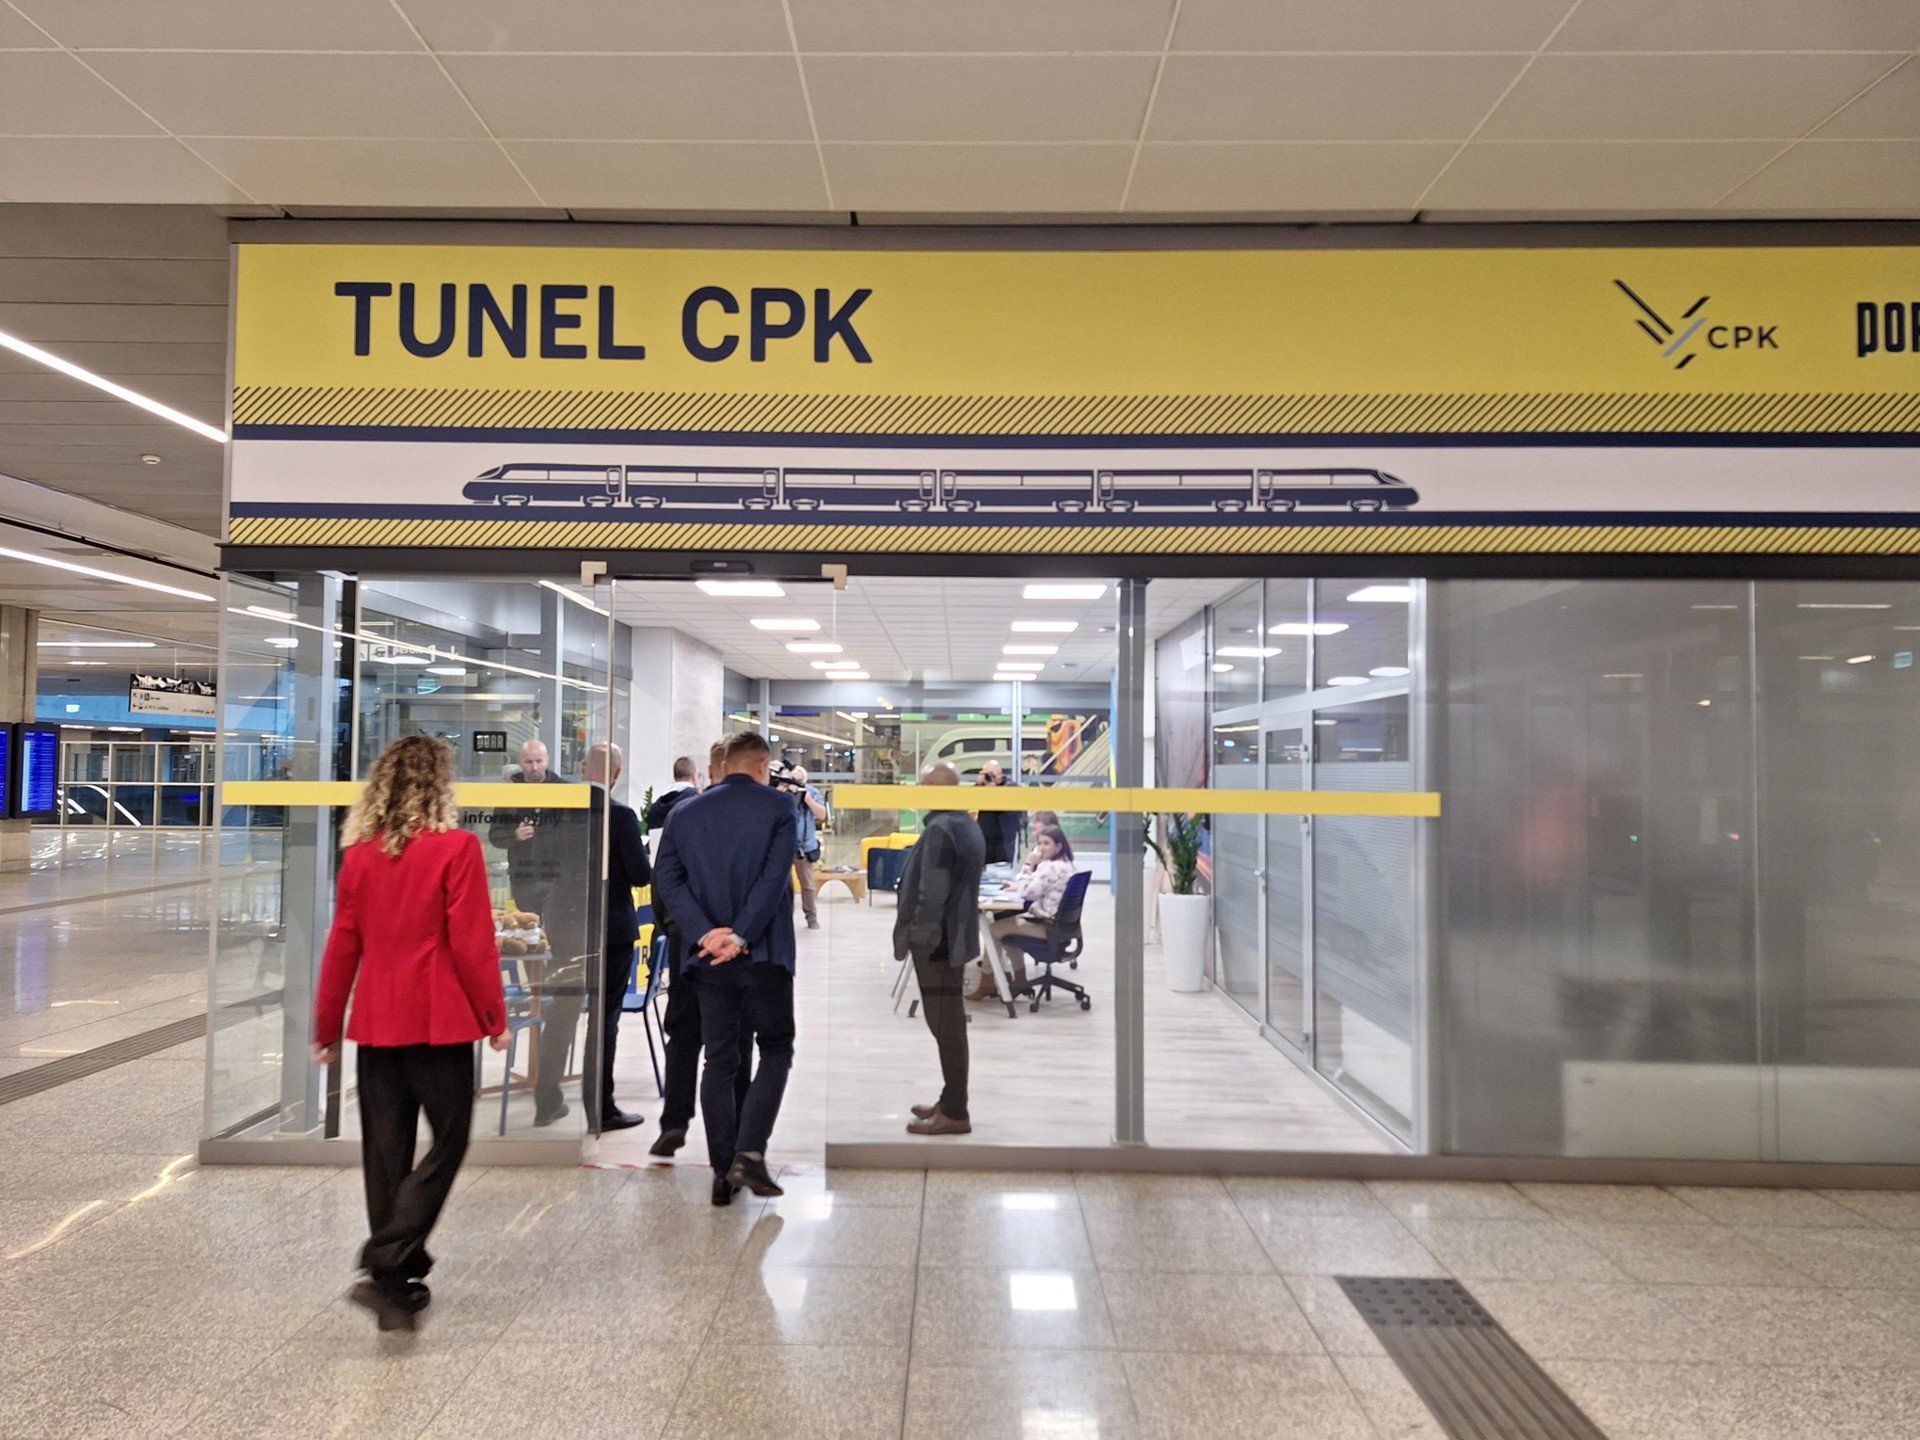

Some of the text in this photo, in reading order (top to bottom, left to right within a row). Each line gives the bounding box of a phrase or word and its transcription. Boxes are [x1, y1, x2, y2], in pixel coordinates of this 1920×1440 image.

[333, 281, 874, 364] TUNEL CPK
[1706, 325, 1779, 350] CPK
